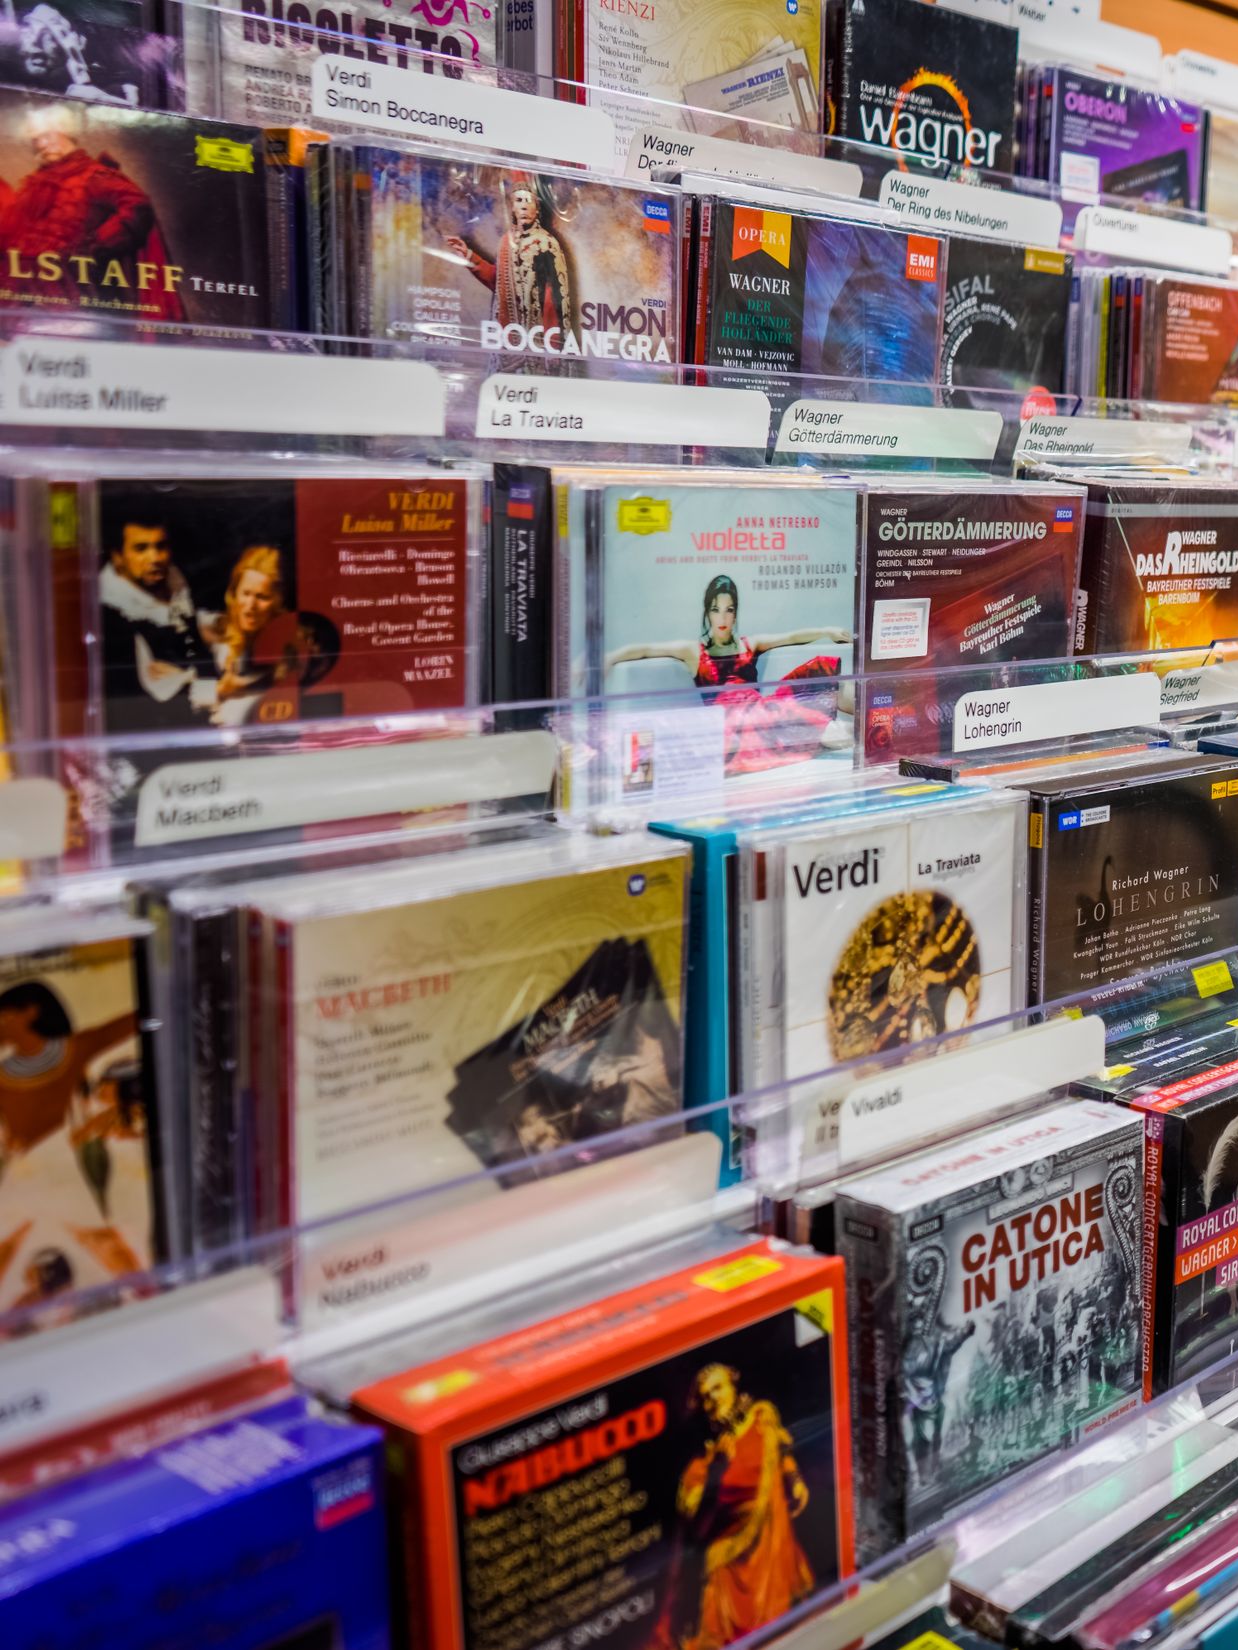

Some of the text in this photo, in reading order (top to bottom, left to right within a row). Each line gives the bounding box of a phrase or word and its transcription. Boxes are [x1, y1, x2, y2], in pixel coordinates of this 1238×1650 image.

[326, 63, 372, 90] Verdi
[326, 89, 485, 135] Simon Boccanegra
[642, 133, 695, 157] Wagner
[889, 178, 930, 199] Wagner
[646, 204, 668, 217] DECCA
[702, 205, 710, 233] EMI
[908, 201, 932, 220] Ring
[934, 205, 952, 222] des
[954, 210, 1009, 231] Nibelungen
[738, 226, 786, 246] OPERA
[909, 252, 935, 268] EMI
[8, 249, 259, 298] LSTAFF TERFEL
[908, 266, 935, 279] CLASSICS
[729, 272, 791, 296] WAGNER
[945, 274, 995, 312] SIFAL
[641, 298, 667, 309] VERDI
[747, 299, 771, 313] DER
[580, 301, 666, 338] SIMON
[724, 311, 791, 329] FLIEGENDE
[480, 319, 672, 364] BOCCANEGRA
[721, 326, 793, 345] HOLLÄNDER
[19, 351, 90, 378] Verdi
[717, 346, 795, 362] VAN DAM VEJZOVIC
[723, 359, 788, 372] MOLL HOFMANN
[19, 384, 167, 413] Luisa Miller
[494, 385, 538, 405] Verdi
[490, 410, 584, 431] La Traviata
[794, 407, 844, 426] Wagner
[788, 427, 899, 448] Götterdämmerung
[1029, 422, 1067, 438] Wagner
[1024, 439, 1044, 451] Das
[387, 490, 455, 511] VERDI
[341, 512, 456, 534] Luisa Miller
[736, 516, 821, 530] ANNA NETREBKO
[880, 507, 908, 517] WAGNER
[1056, 509, 1073, 519] DECCA
[878, 517, 1047, 542] GÖTTERDÄMMERUNG
[1182, 529, 1217, 546] WAGNER
[876, 558, 933, 568] GREINDL NILSSON
[877, 548, 918, 558] WINDGASSEN
[922, 548, 947, 557] STEWART
[758, 561, 848, 577] ROLANDO VILLAZÓN
[1136, 553, 1163, 576] DAS
[515, 529, 528, 643] LA TRAVIATA
[752, 578, 838, 591] THOMAS HAMPSON
[875, 578, 895, 589] BÖHM
[1146, 577, 1231, 593] BAYREUTHER FESTSPIELE
[983, 593, 1016, 615] Wagner
[1158, 592, 1200, 606] BARENBOIM
[963, 594, 1038, 638] Götterdämmerung
[1075, 604, 1088, 650] WAGNER
[959, 602, 1042, 653] Bayreuther Festspiele
[979, 624, 1025, 655] Karl Böhm
[1164, 674, 1201, 690] Wagner
[964, 699, 1011, 718] Wagner
[1159, 689, 1200, 706] Siegfried
[963, 718, 1023, 740] Lohengrin
[1212, 782, 1227, 794] Profil
[154, 798, 262, 829] Macbeth
[793, 847, 880, 898] Verdi
[918, 852, 981, 876] La Traviata
[1112, 865, 1189, 891] Richard Wagner
[1076, 873, 1220, 927] LOHENGRIN
[1029, 897, 1042, 993] Richard Wagner
[1099, 933, 1182, 963] WDR NDR
[850, 1085, 903, 1118] Vivaldi
[960, 1182, 1105, 1274] CATONE
[1182, 1213, 1222, 1249] ROYAL
[962, 1222, 1106, 1313] IN UTICA
[1180, 1240, 1230, 1277] WAGNER
